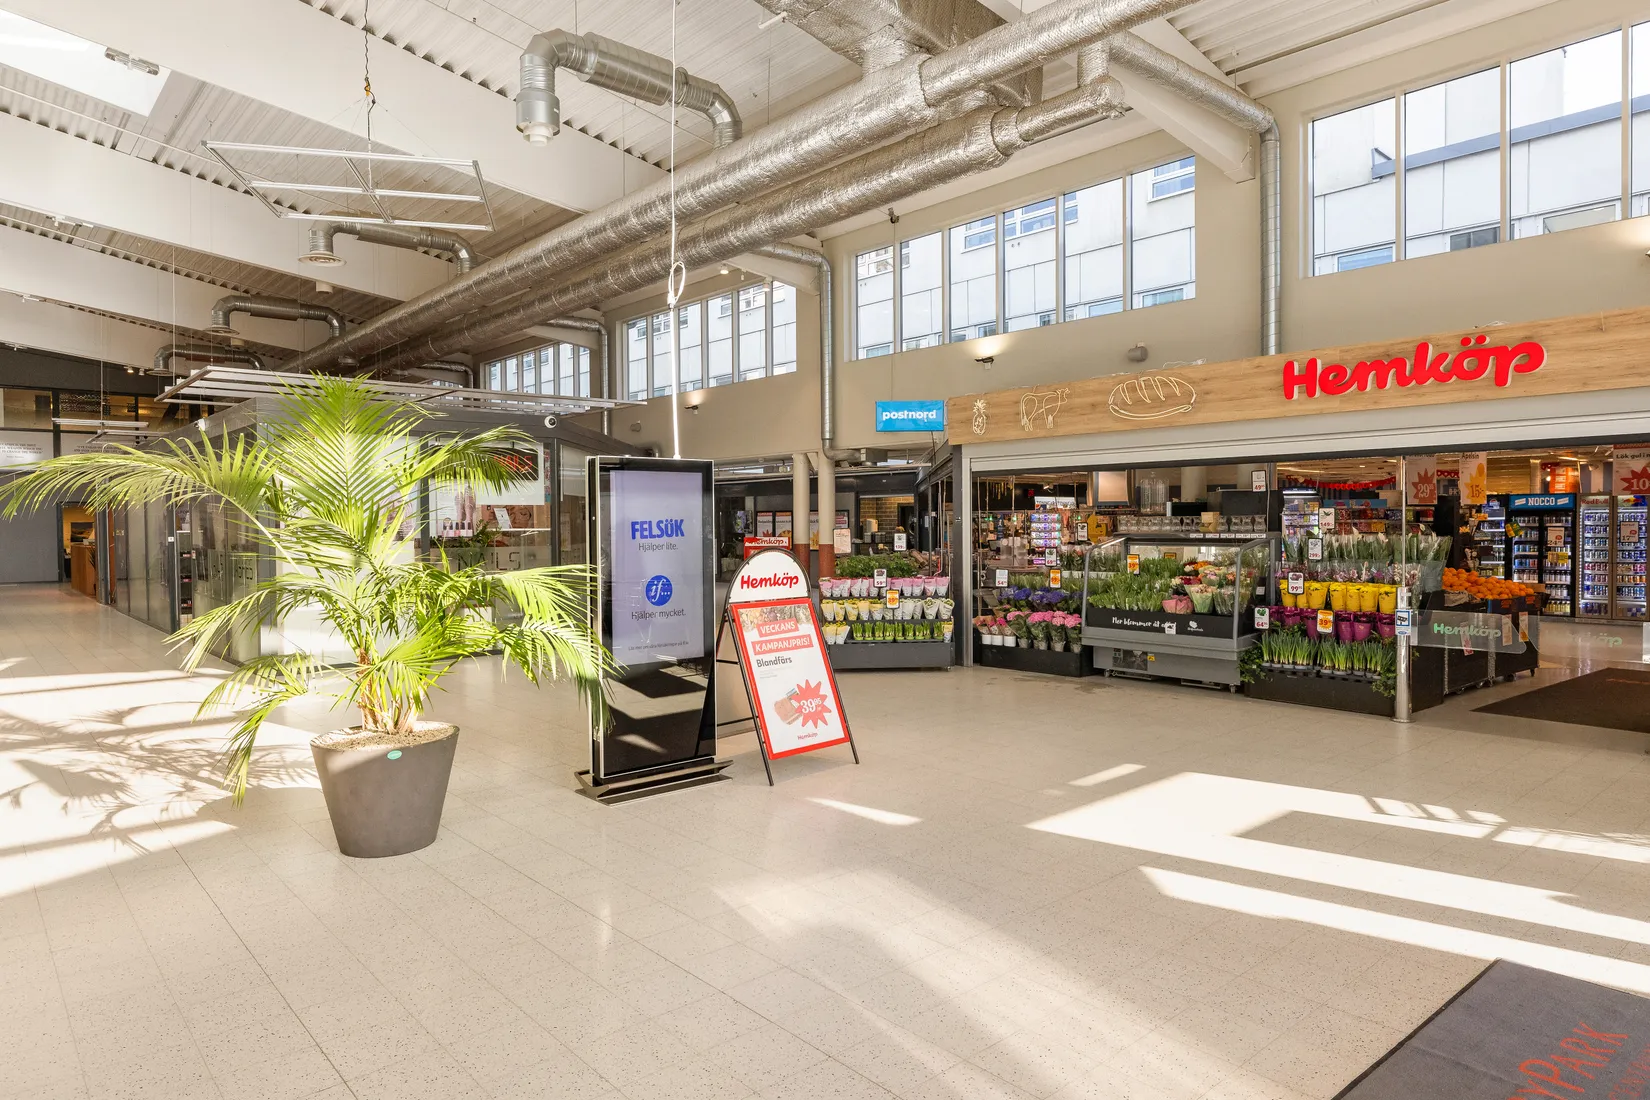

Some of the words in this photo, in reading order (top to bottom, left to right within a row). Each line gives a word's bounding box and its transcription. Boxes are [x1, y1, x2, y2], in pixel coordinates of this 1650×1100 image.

[1283, 334, 1547, 400] Hemköp
[882, 409, 937, 422] postnord
[1630, 452, 1642, 460] gul
[1528, 497, 1556, 506] NOCCO
[638, 542, 665, 552] Hjälper
[665, 542, 679, 550] lite.
[741, 572, 799, 589] Hemköp
[631, 610, 658, 622] Hjälper
[658, 608, 686, 619] mycket.
[760, 621, 796, 634] VECKANS
[1433, 622, 1502, 639] Hemköp
[755, 638, 811, 652] KAMPANJPRIS!
[756, 656, 793, 668] Blandfärs
[1506, 1021, 1629, 1100] YPARK
